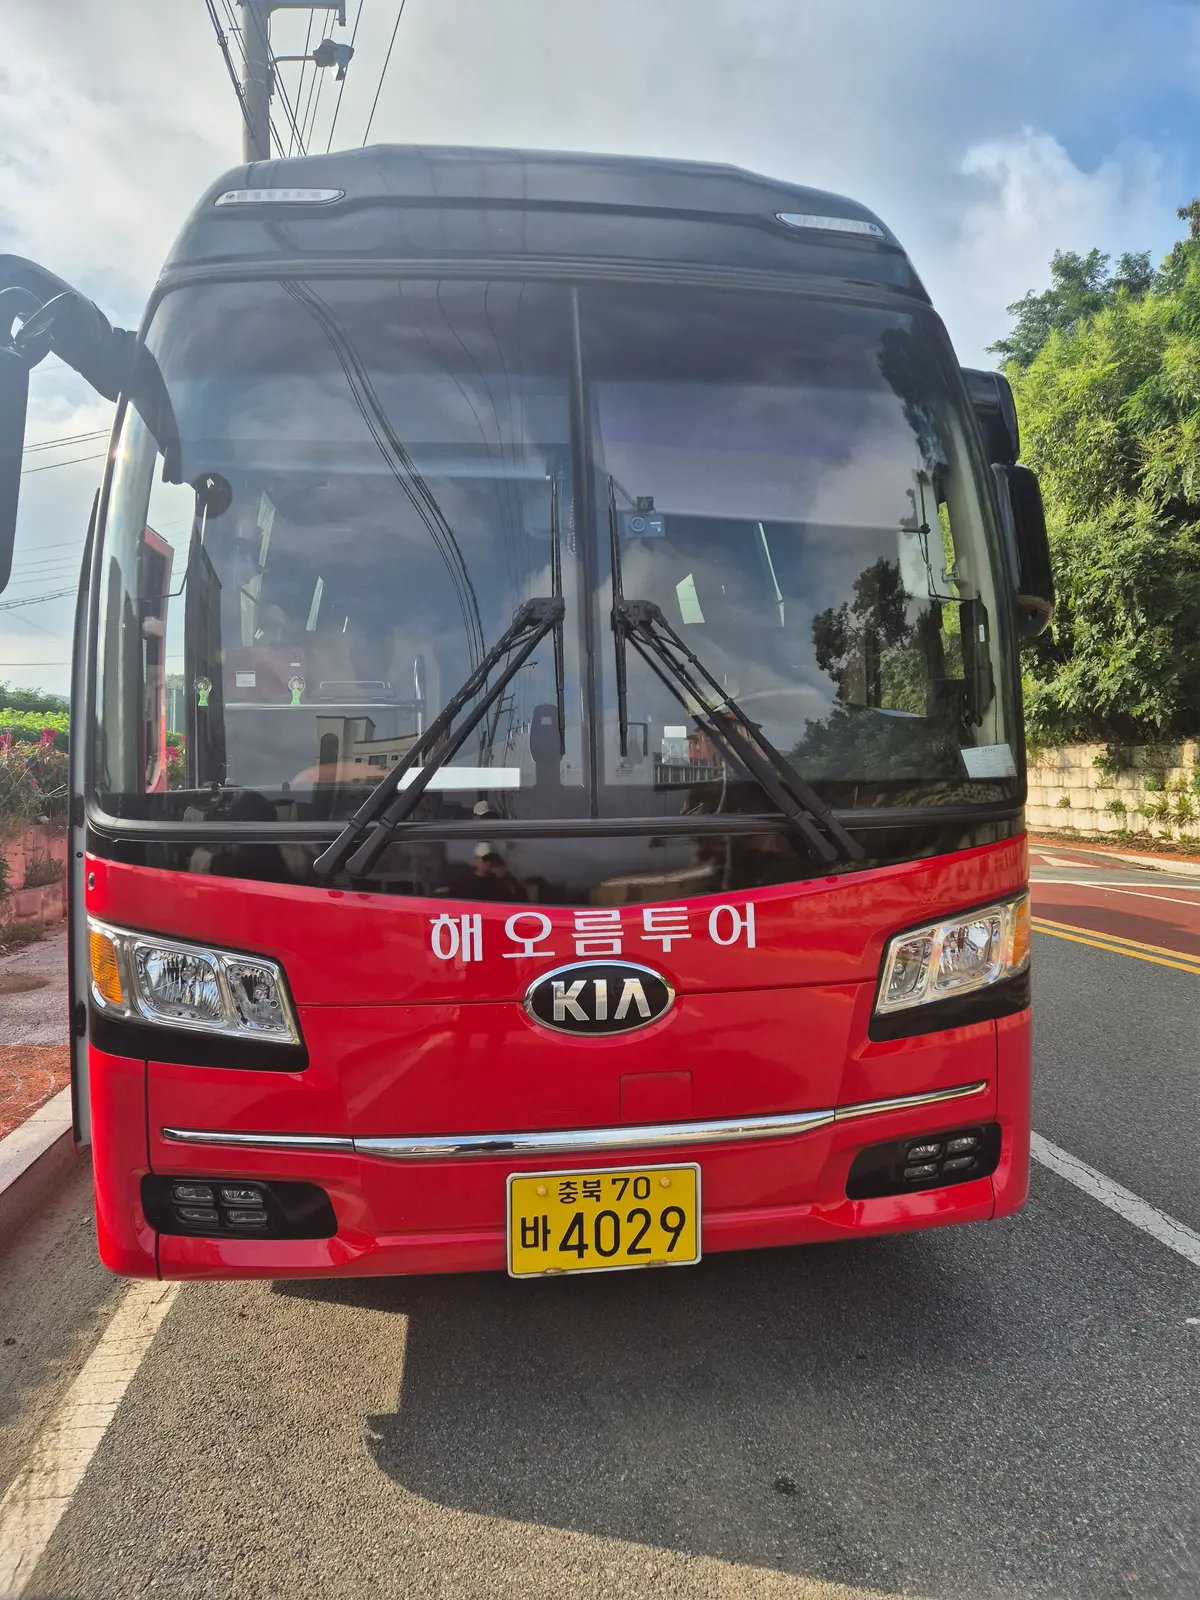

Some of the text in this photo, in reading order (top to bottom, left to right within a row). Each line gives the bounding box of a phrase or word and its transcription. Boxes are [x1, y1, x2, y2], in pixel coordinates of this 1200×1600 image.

[429, 902, 757, 962] 해오름투어
[551, 978, 652, 1021] KIA
[558, 1176, 651, 1204] 충북 70
